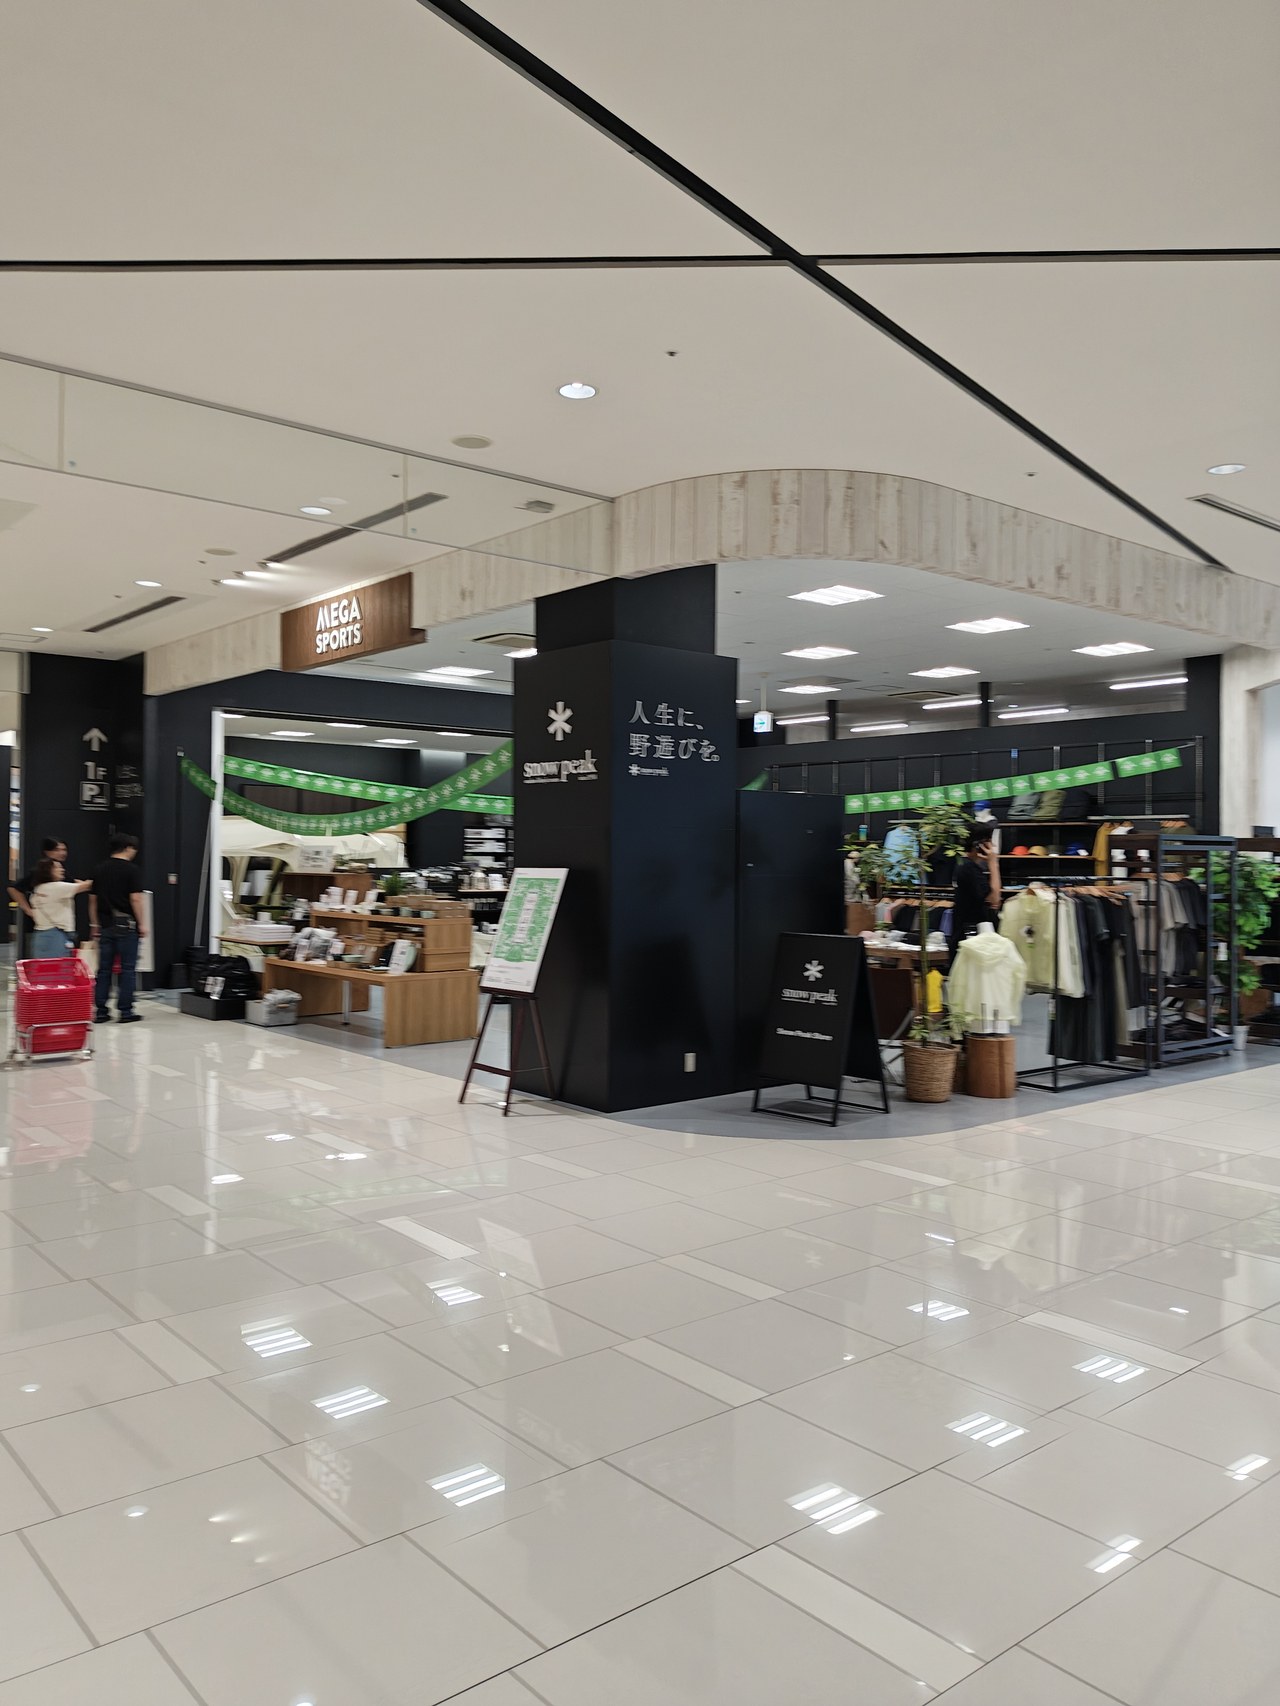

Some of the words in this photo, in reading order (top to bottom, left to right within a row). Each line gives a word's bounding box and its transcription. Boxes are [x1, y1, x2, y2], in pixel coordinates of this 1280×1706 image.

[315, 595, 361, 632] MEGA
[315, 623, 362, 654] SPORTS
[628, 700, 704, 730] 人生に、
[628, 733, 720, 762] 野遊びを。
[83, 761, 108, 780] 1F
